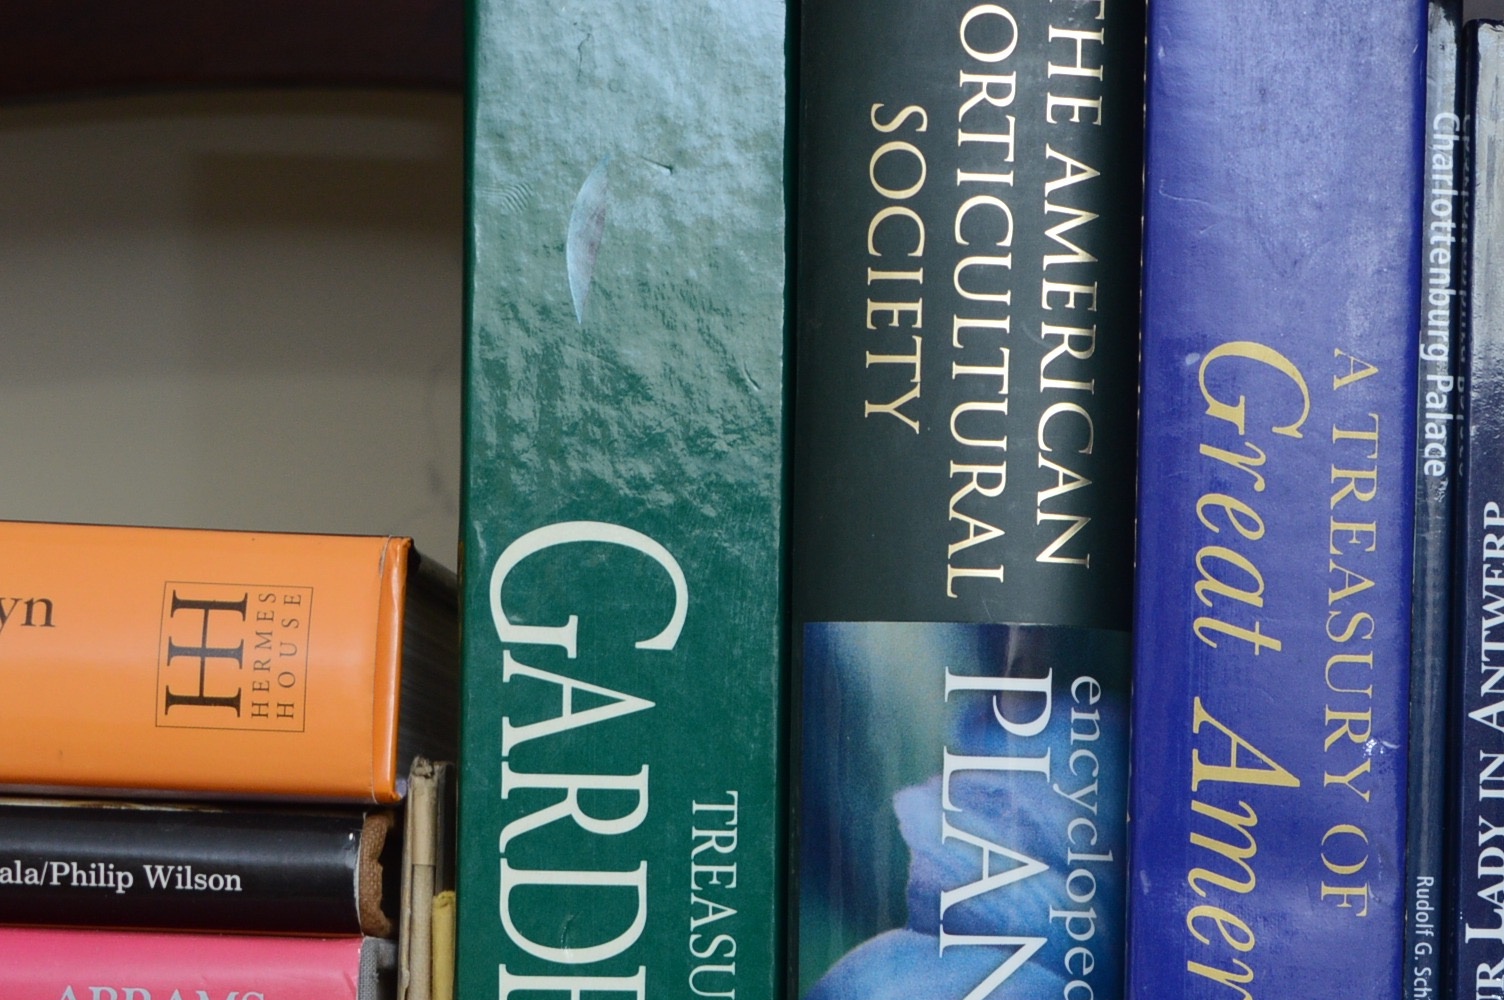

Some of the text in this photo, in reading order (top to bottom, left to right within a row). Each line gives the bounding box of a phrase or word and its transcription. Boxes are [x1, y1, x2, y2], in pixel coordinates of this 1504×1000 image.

[864, 103, 929, 435] SOCIETY
[1036, 143, 1101, 570] AMERICAN
[1419, 111, 1461, 478] Charlottenburg Palace
[1192, 340, 1311, 656] Great
[251, 592, 277, 719] HERMES
[276, 593, 302, 720] HOUSE
[1320, 347, 1380, 918] A TREASURY OF
[143, 864, 244, 892] Wilson
[1414, 942, 1433, 961] G.
[1415, 876, 1435, 937] Rudolf
